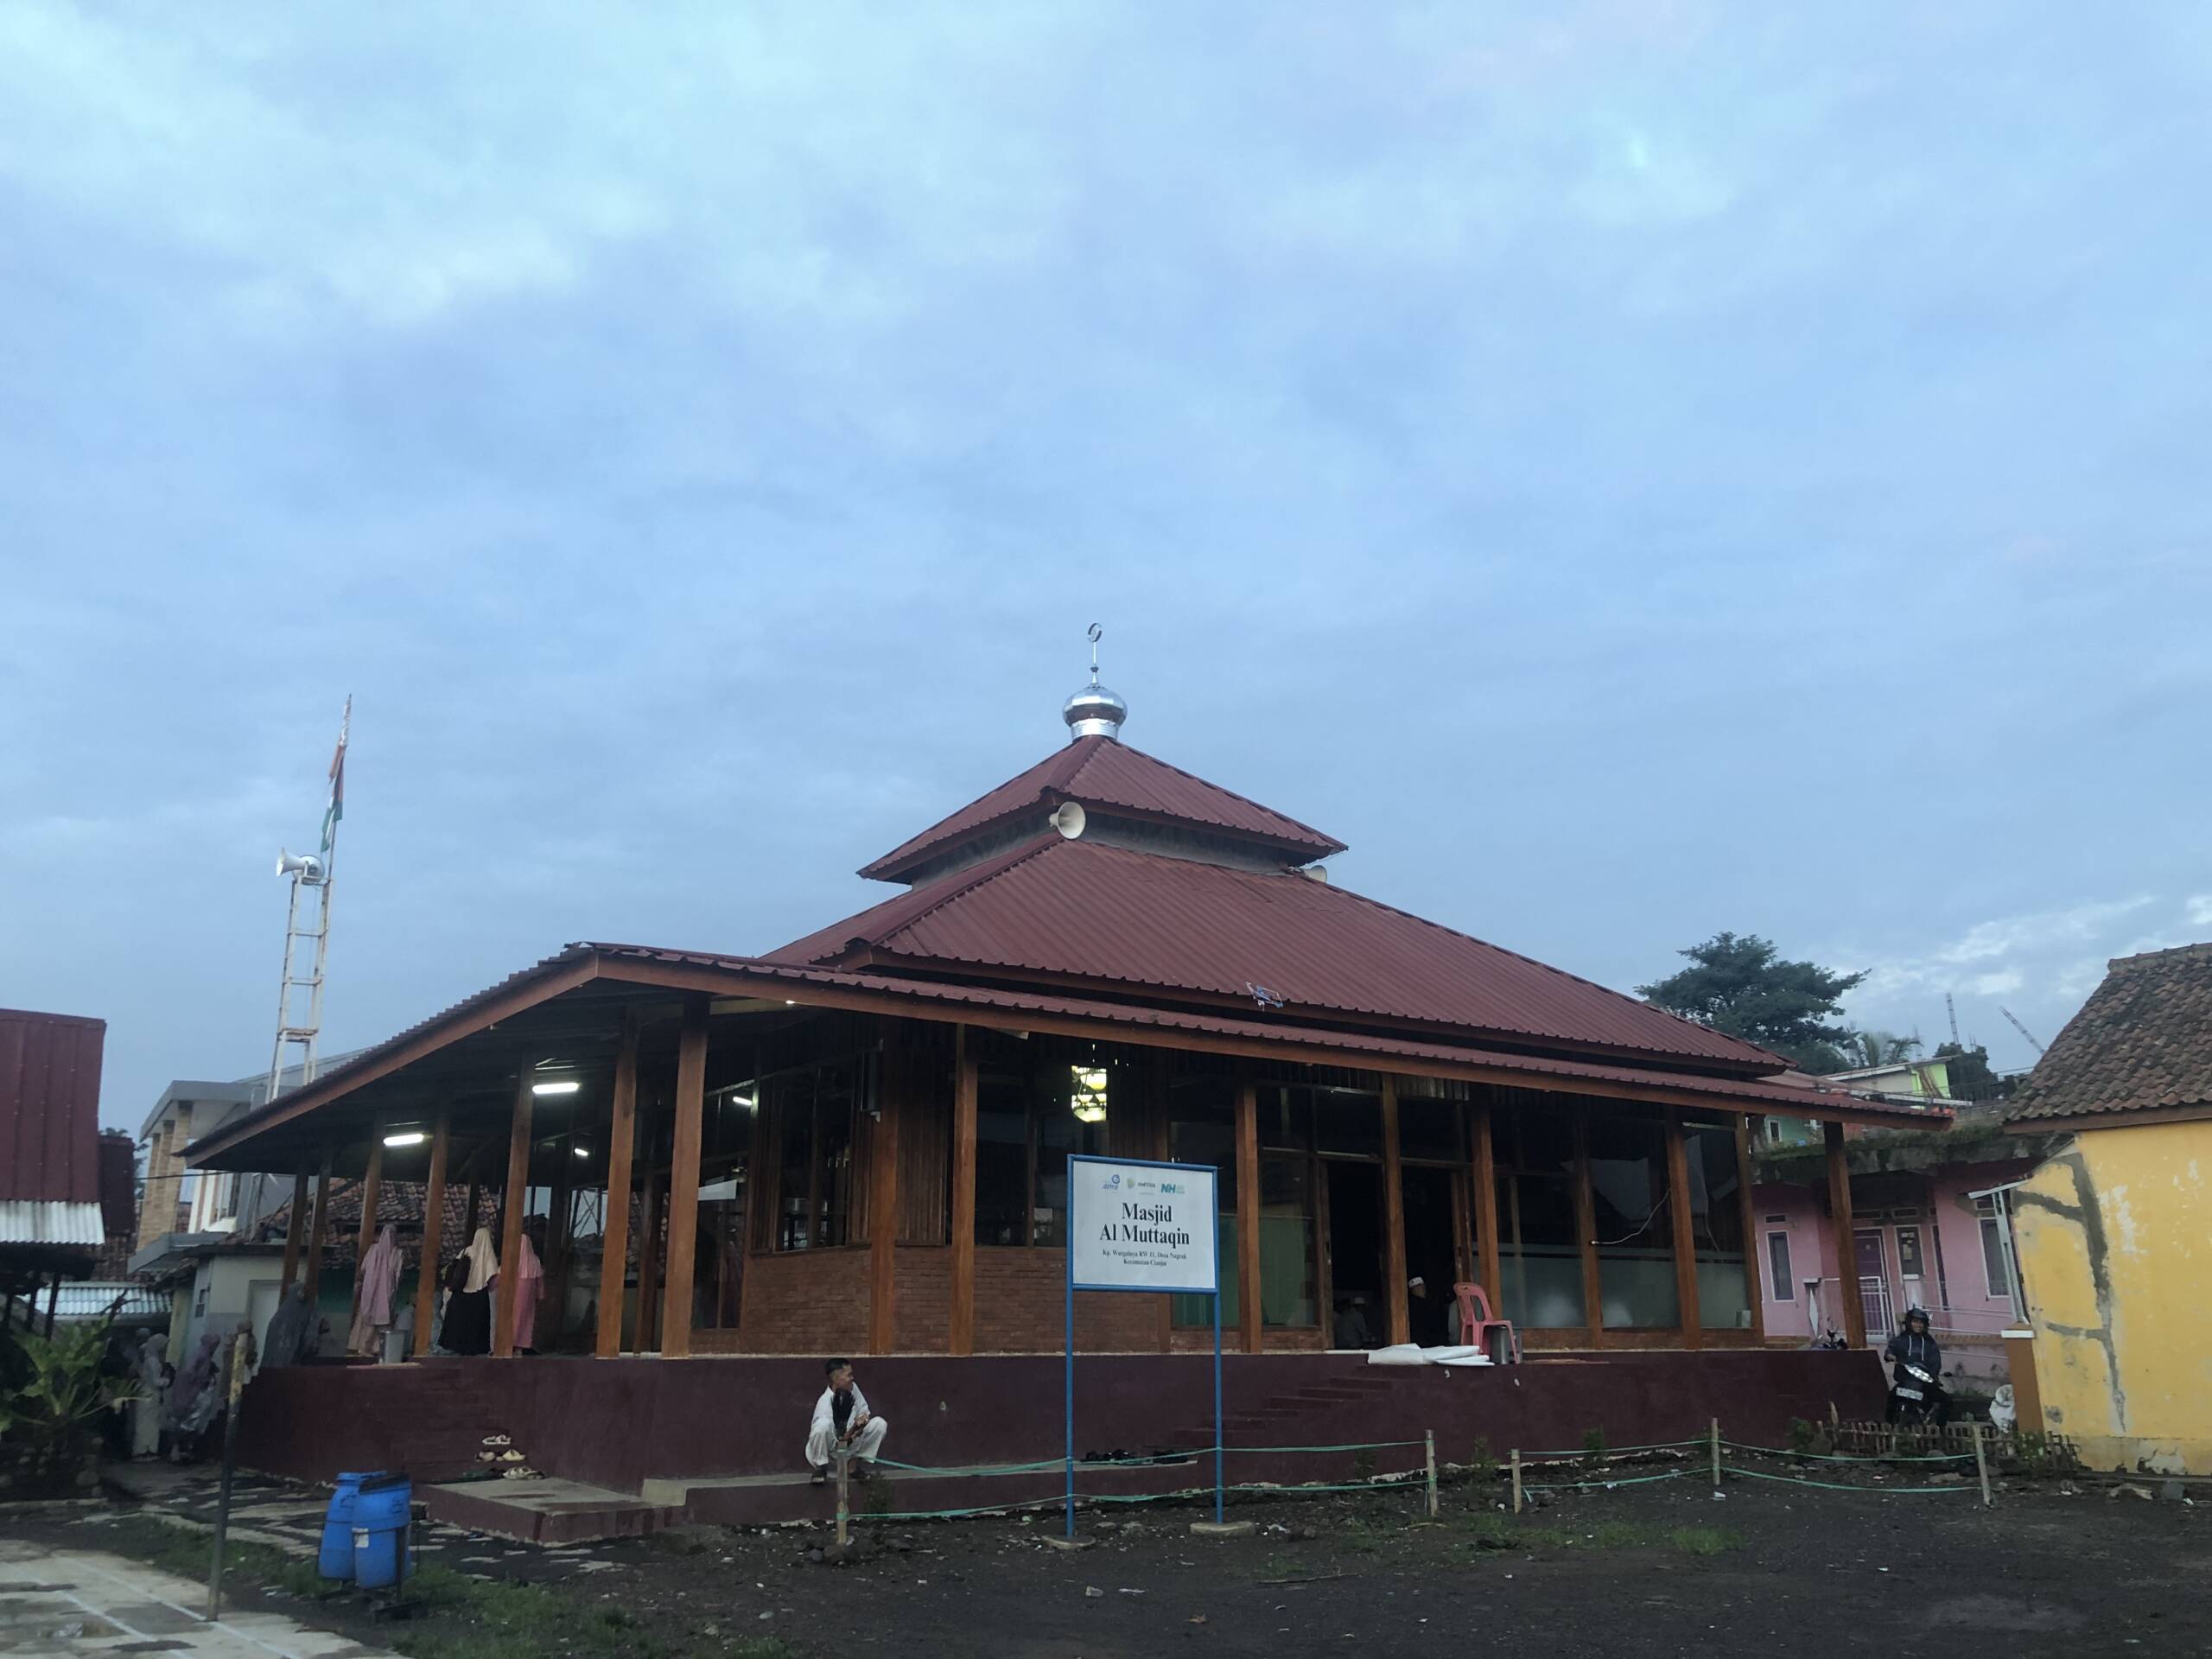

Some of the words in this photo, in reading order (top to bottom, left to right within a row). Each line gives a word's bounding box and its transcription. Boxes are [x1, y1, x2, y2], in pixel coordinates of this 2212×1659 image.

[1160, 1183, 1176, 1193] NH
[1122, 1202, 1172, 1226] Masjid
[1099, 1224, 1116, 1241] Al
[1122, 1224, 1190, 1249] Muttaqin
